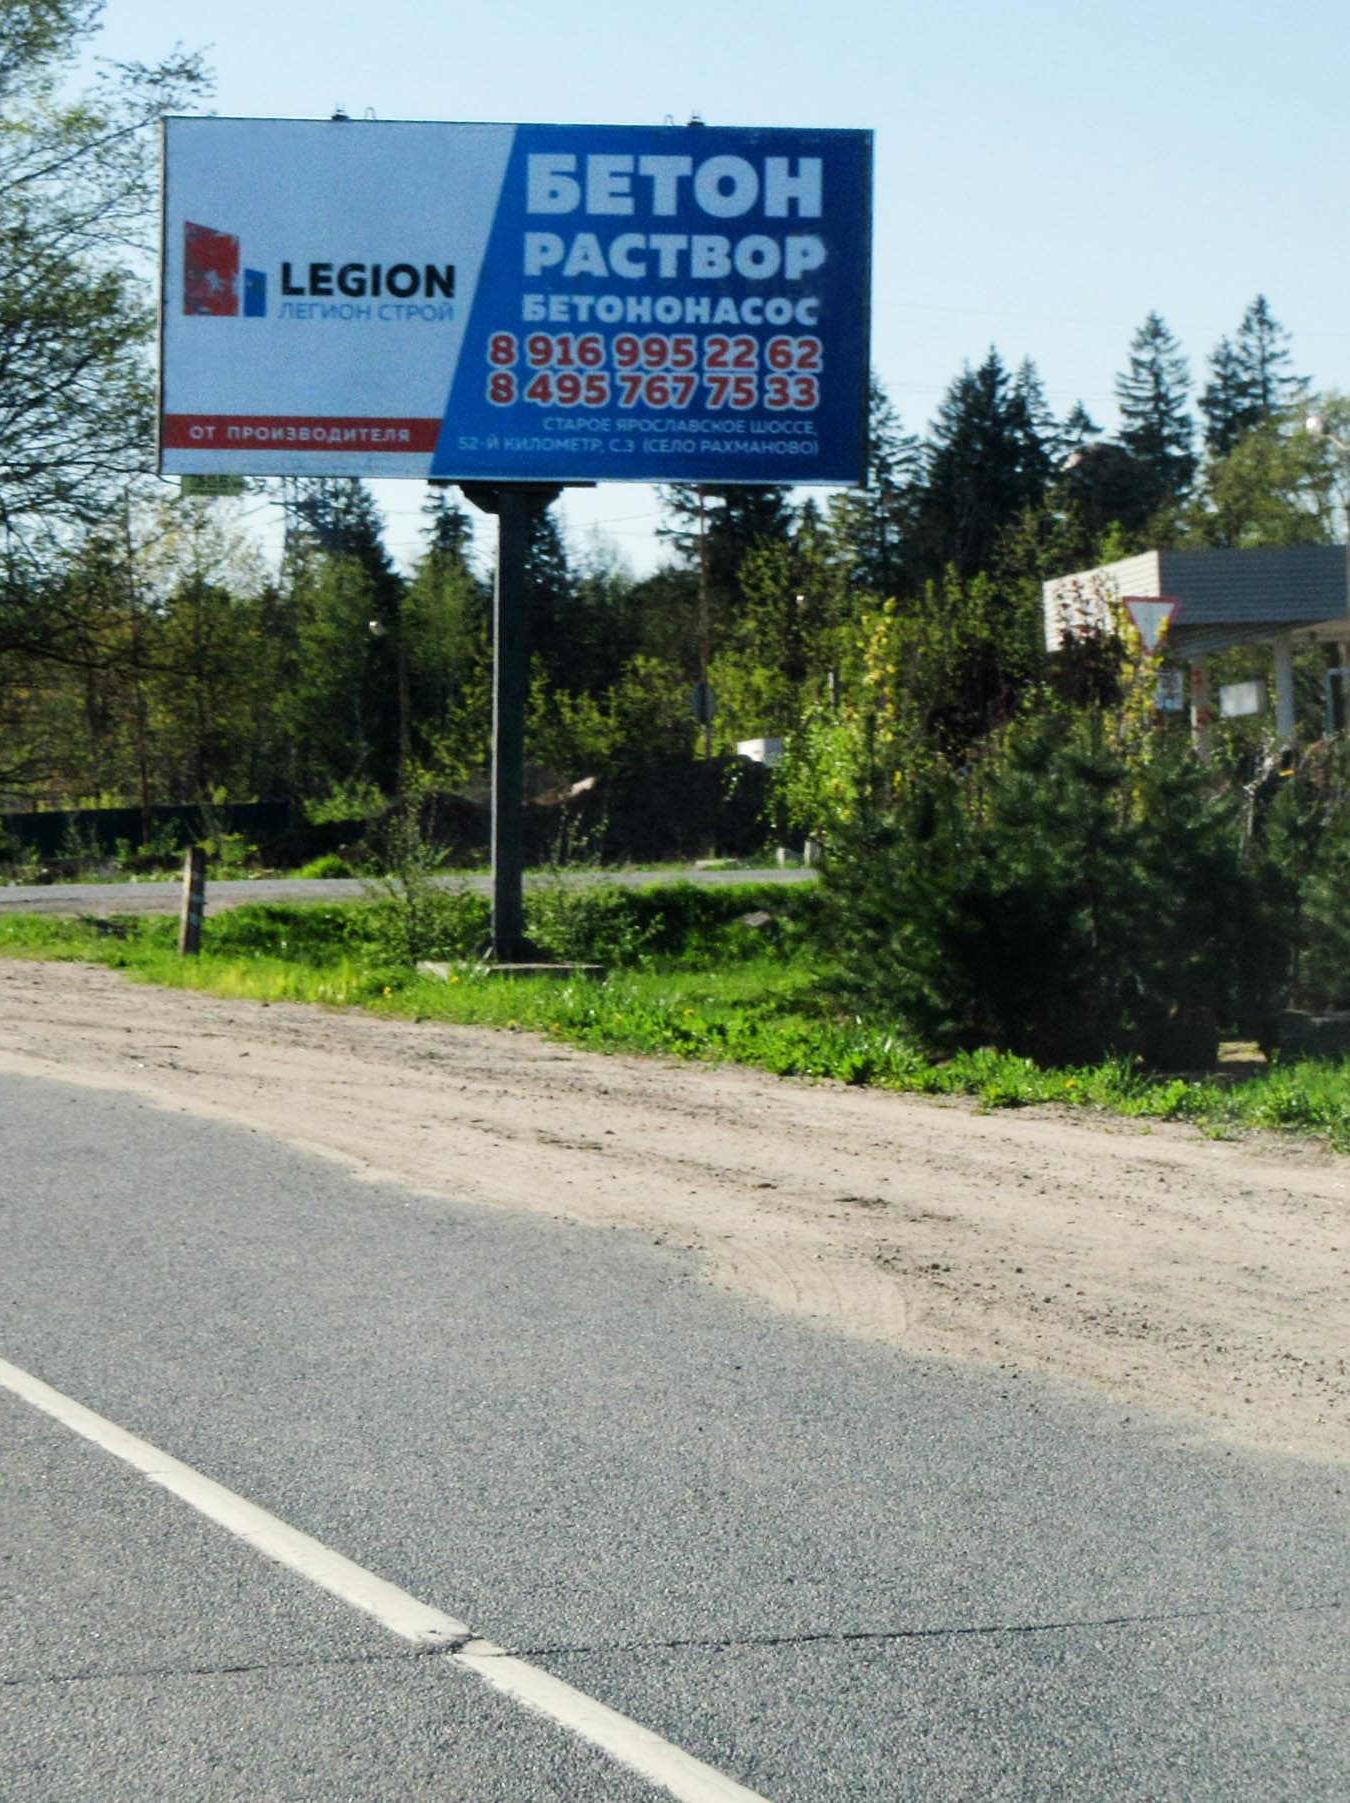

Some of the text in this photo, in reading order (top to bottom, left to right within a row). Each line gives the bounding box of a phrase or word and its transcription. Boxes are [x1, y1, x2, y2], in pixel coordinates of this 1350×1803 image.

[526, 153, 823, 218] БЕТОН
[523, 231, 827, 280] РАСТВОР
[281, 262, 456, 299] LEGION
[278, 302, 455, 322] ЛЕГИОН СТРОЙ
[521, 293, 819, 326] БЕТОНОНАСОС
[488, 331, 823, 373] 8 916 995 22 62
[487, 369, 820, 411] 8 495 767 75 33
[189, 426, 411, 442] ОТ ПРОИЗВОДИТЕЛЯ
[458, 434, 499, 451] 52-Й
[543, 417, 818, 436] СТАРОЕ ЯРОСЛАВСКОЕ ШОССЕ,
